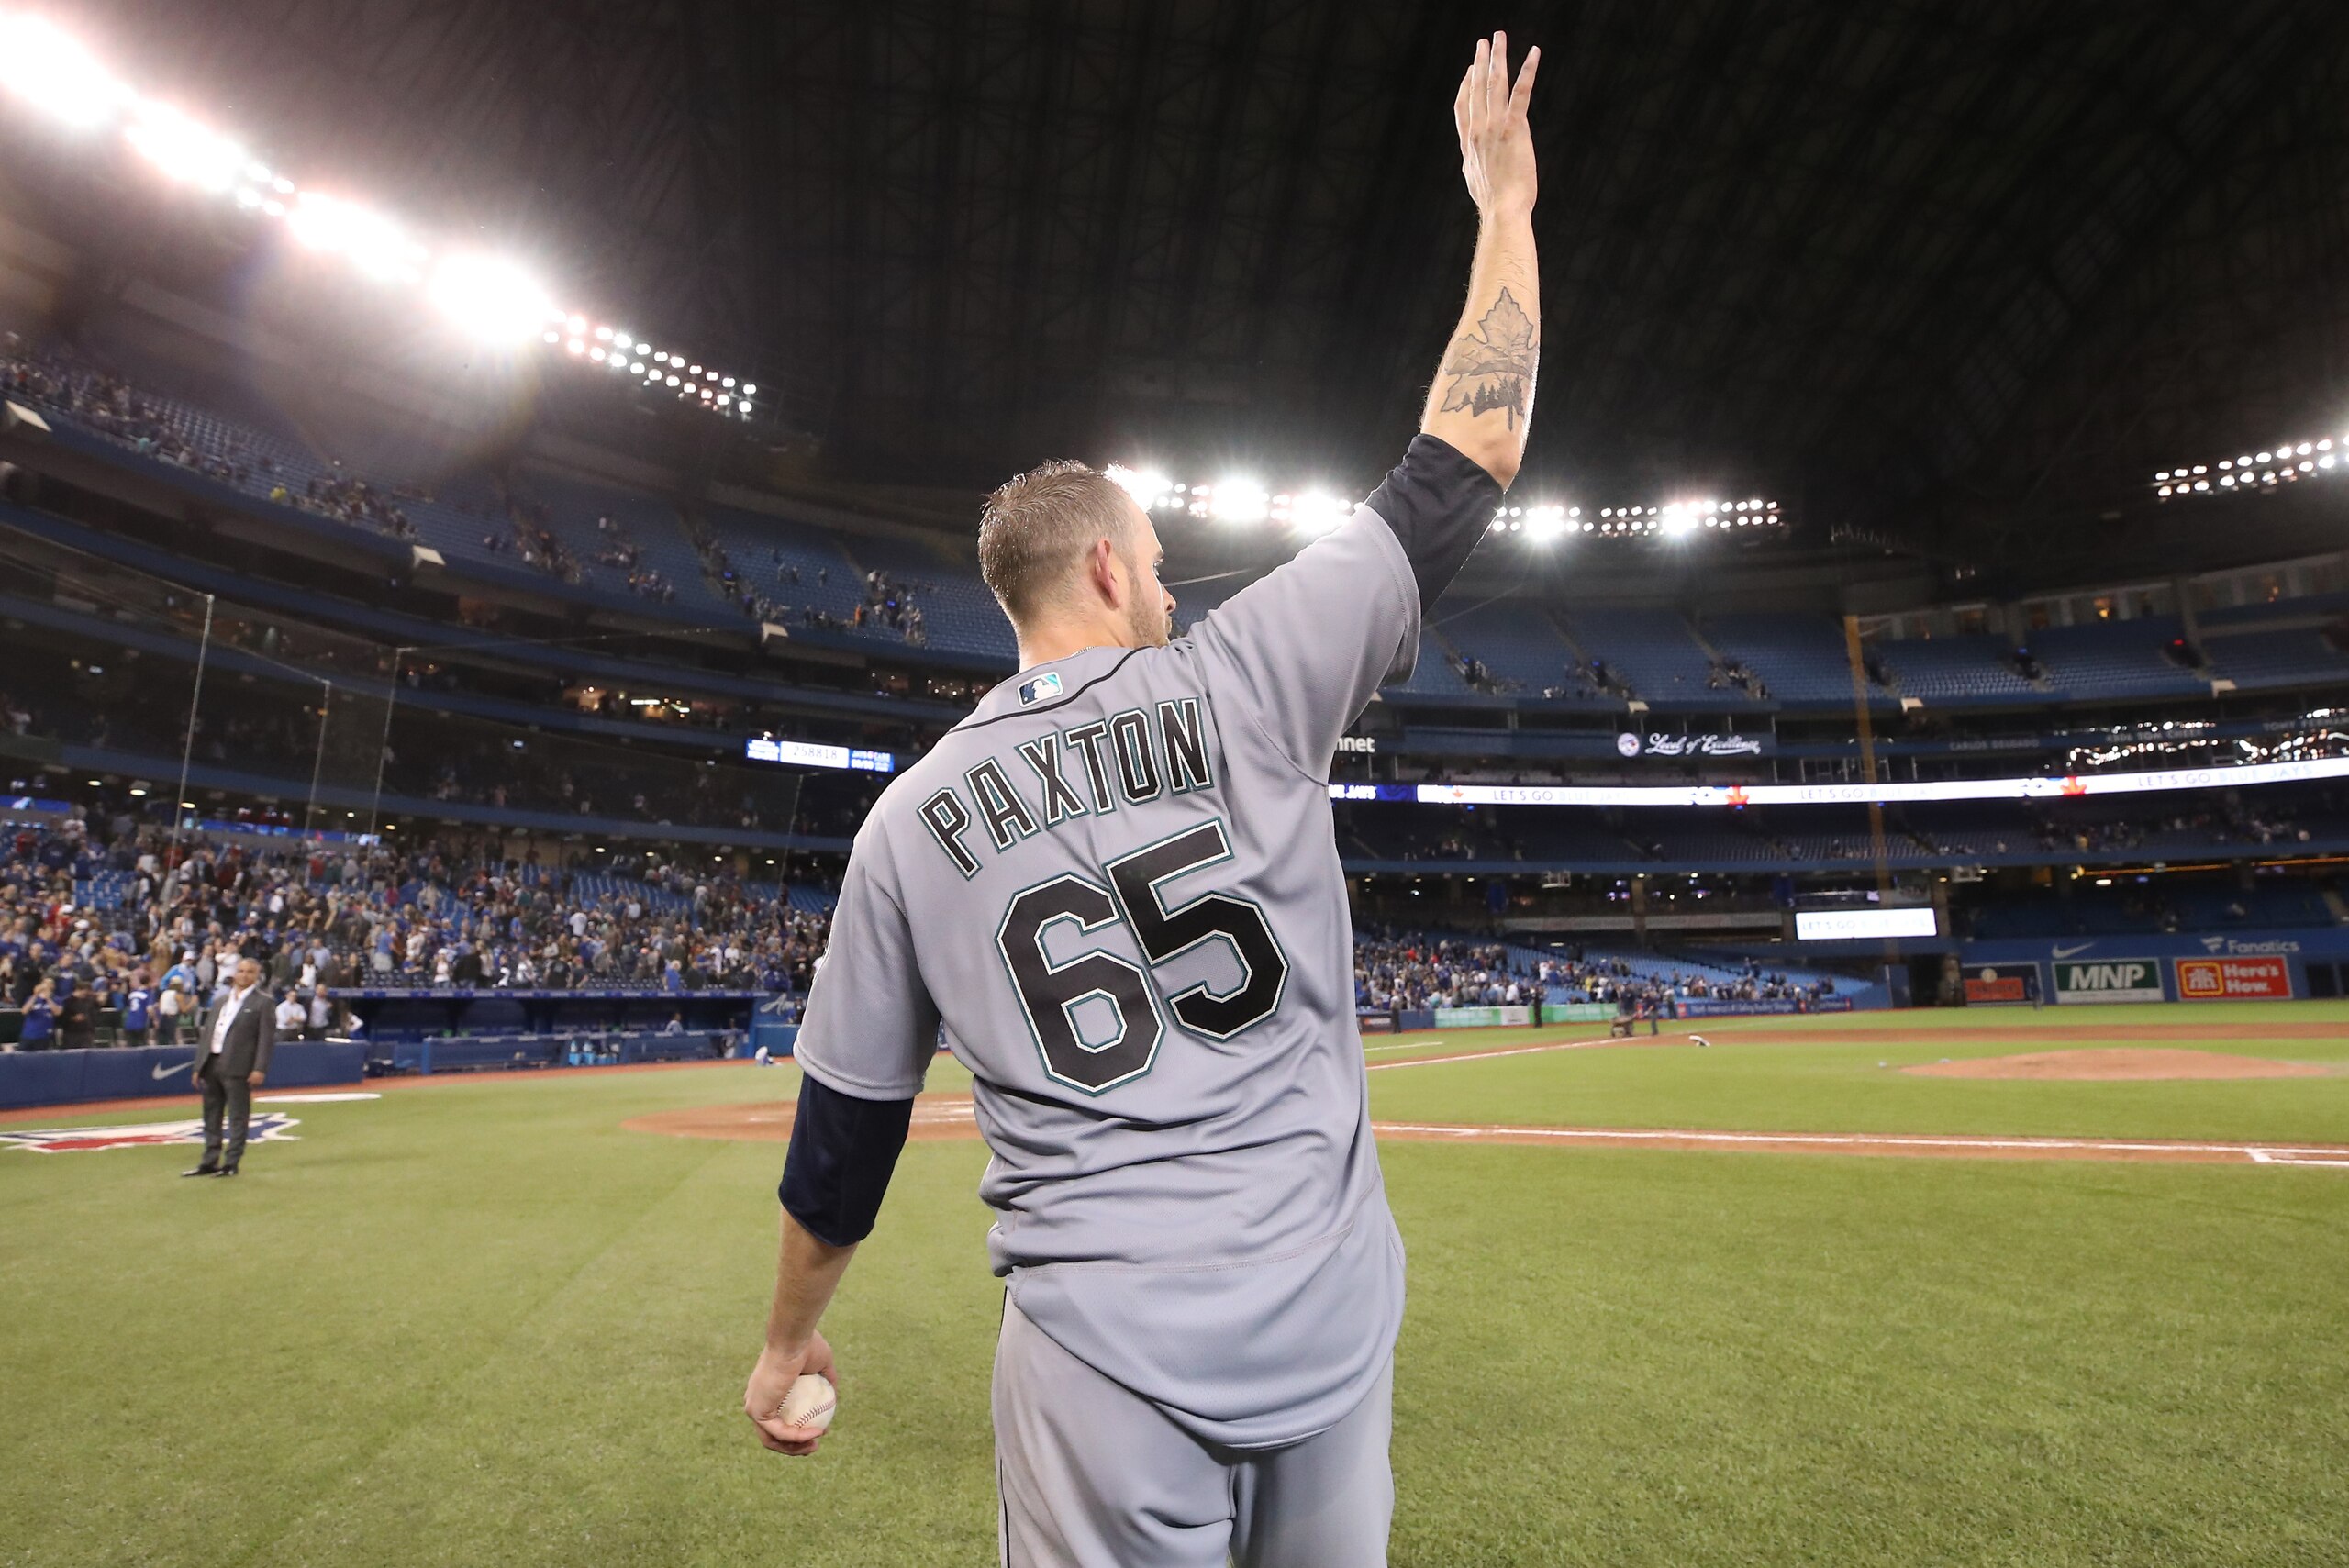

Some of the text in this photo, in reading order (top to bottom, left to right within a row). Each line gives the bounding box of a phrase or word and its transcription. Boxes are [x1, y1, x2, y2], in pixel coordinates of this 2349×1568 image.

[1645, 733, 1761, 754] Level of Excellence
[2138, 773, 2179, 788] LET'S
[2186, 772, 2211, 785] GO
[917, 697, 1214, 881] PAXTON
[1493, 789, 1527, 801] LET'S
[1531, 790, 1553, 802] GO
[1800, 787, 1837, 800] LET'S
[1842, 786, 1864, 799] GO
[1836, 919, 1856, 930] GO
[2228, 939, 2299, 955] Fanatics
[995, 817, 1290, 1097] 65
[2068, 963, 2145, 991] MNP
[2223, 963, 2279, 977] Here's
[2226, 979, 2272, 993] How.
